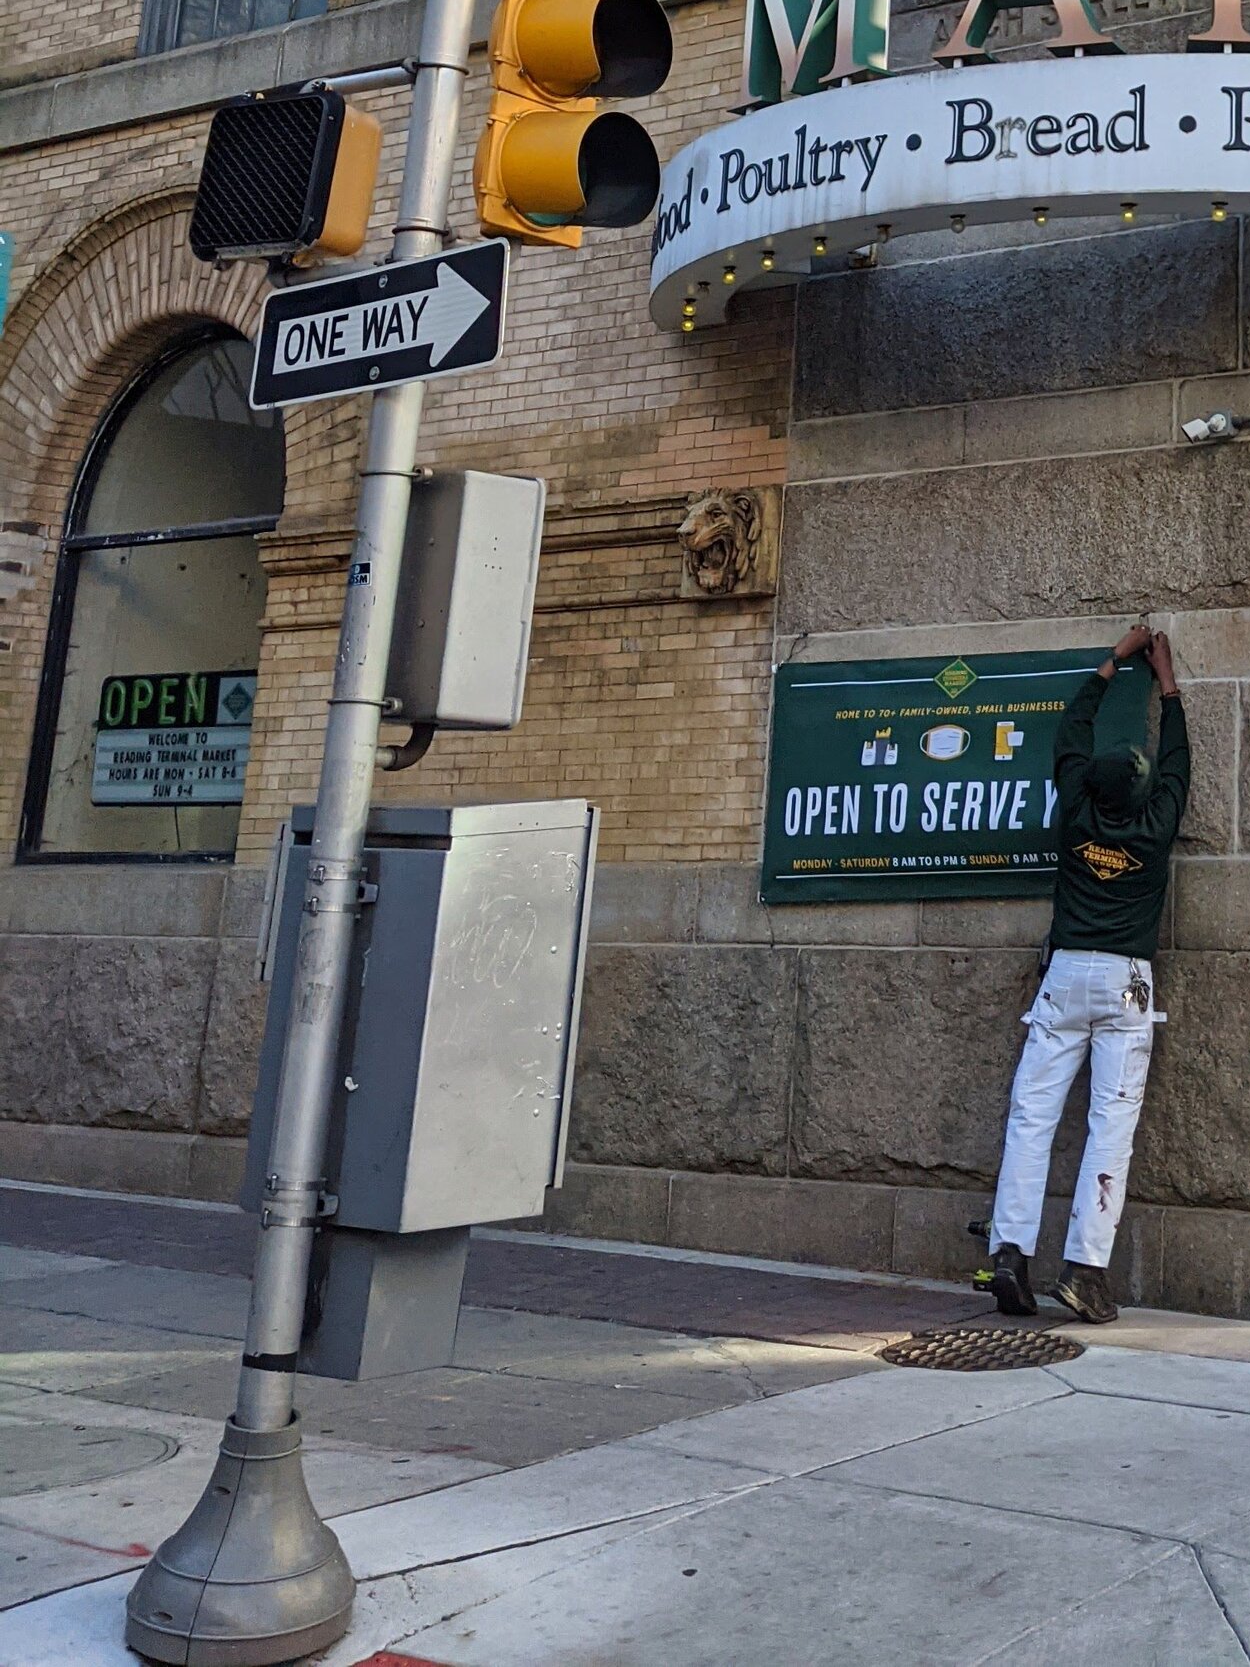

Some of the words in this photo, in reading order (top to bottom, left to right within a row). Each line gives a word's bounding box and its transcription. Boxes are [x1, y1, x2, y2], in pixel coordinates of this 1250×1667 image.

[716, 123, 889, 214] Poultry
[945, 84, 1150, 165] Bread
[284, 313, 349, 366] ONE
[362, 295, 429, 352] WAY
[105, 674, 207, 726] OPEN
[836, 710, 860, 720] HOME
[864, 709, 875, 719] TO
[879, 708, 896, 719] 70+
[899, 705, 972, 718] FAMILY-OWNED,
[976, 703, 1003, 714] SMALL
[1007, 701, 1065, 713] BUSINESSES
[148, 733, 189, 745] WELCOME
[196, 732, 208, 744] TO
[113, 750, 152, 764] READING
[157, 750, 198, 762] TERMINAL
[202, 749, 237, 761] MARKET
[109, 768, 138, 780] HOURS
[143, 768, 160, 780] ARE
[163, 768, 185, 780] MON
[198, 766, 217, 779] SAT
[152, 784, 172, 797] SUN
[177, 784, 193, 797] 9-4
[785, 785, 861, 836] OPEN
[873, 782, 908, 834] TO
[921, 780, 1031, 832] SERVE
[793, 858, 833, 870] MONDAY
[840, 857, 891, 869] SATURDAY
[893, 857, 899, 867] 8
[901, 856, 917, 867] AM
[918, 856, 932, 866] TO
[943, 856, 958, 866] PM
[960, 855, 967, 866] &
[969, 854, 1011, 865] SUNDAY
[1013, 853, 1020, 864] 9
[1022, 853, 1039, 864] AM
[1043, 852, 1059, 862] TO
[1083, 850, 1130, 867] TERMINAL
